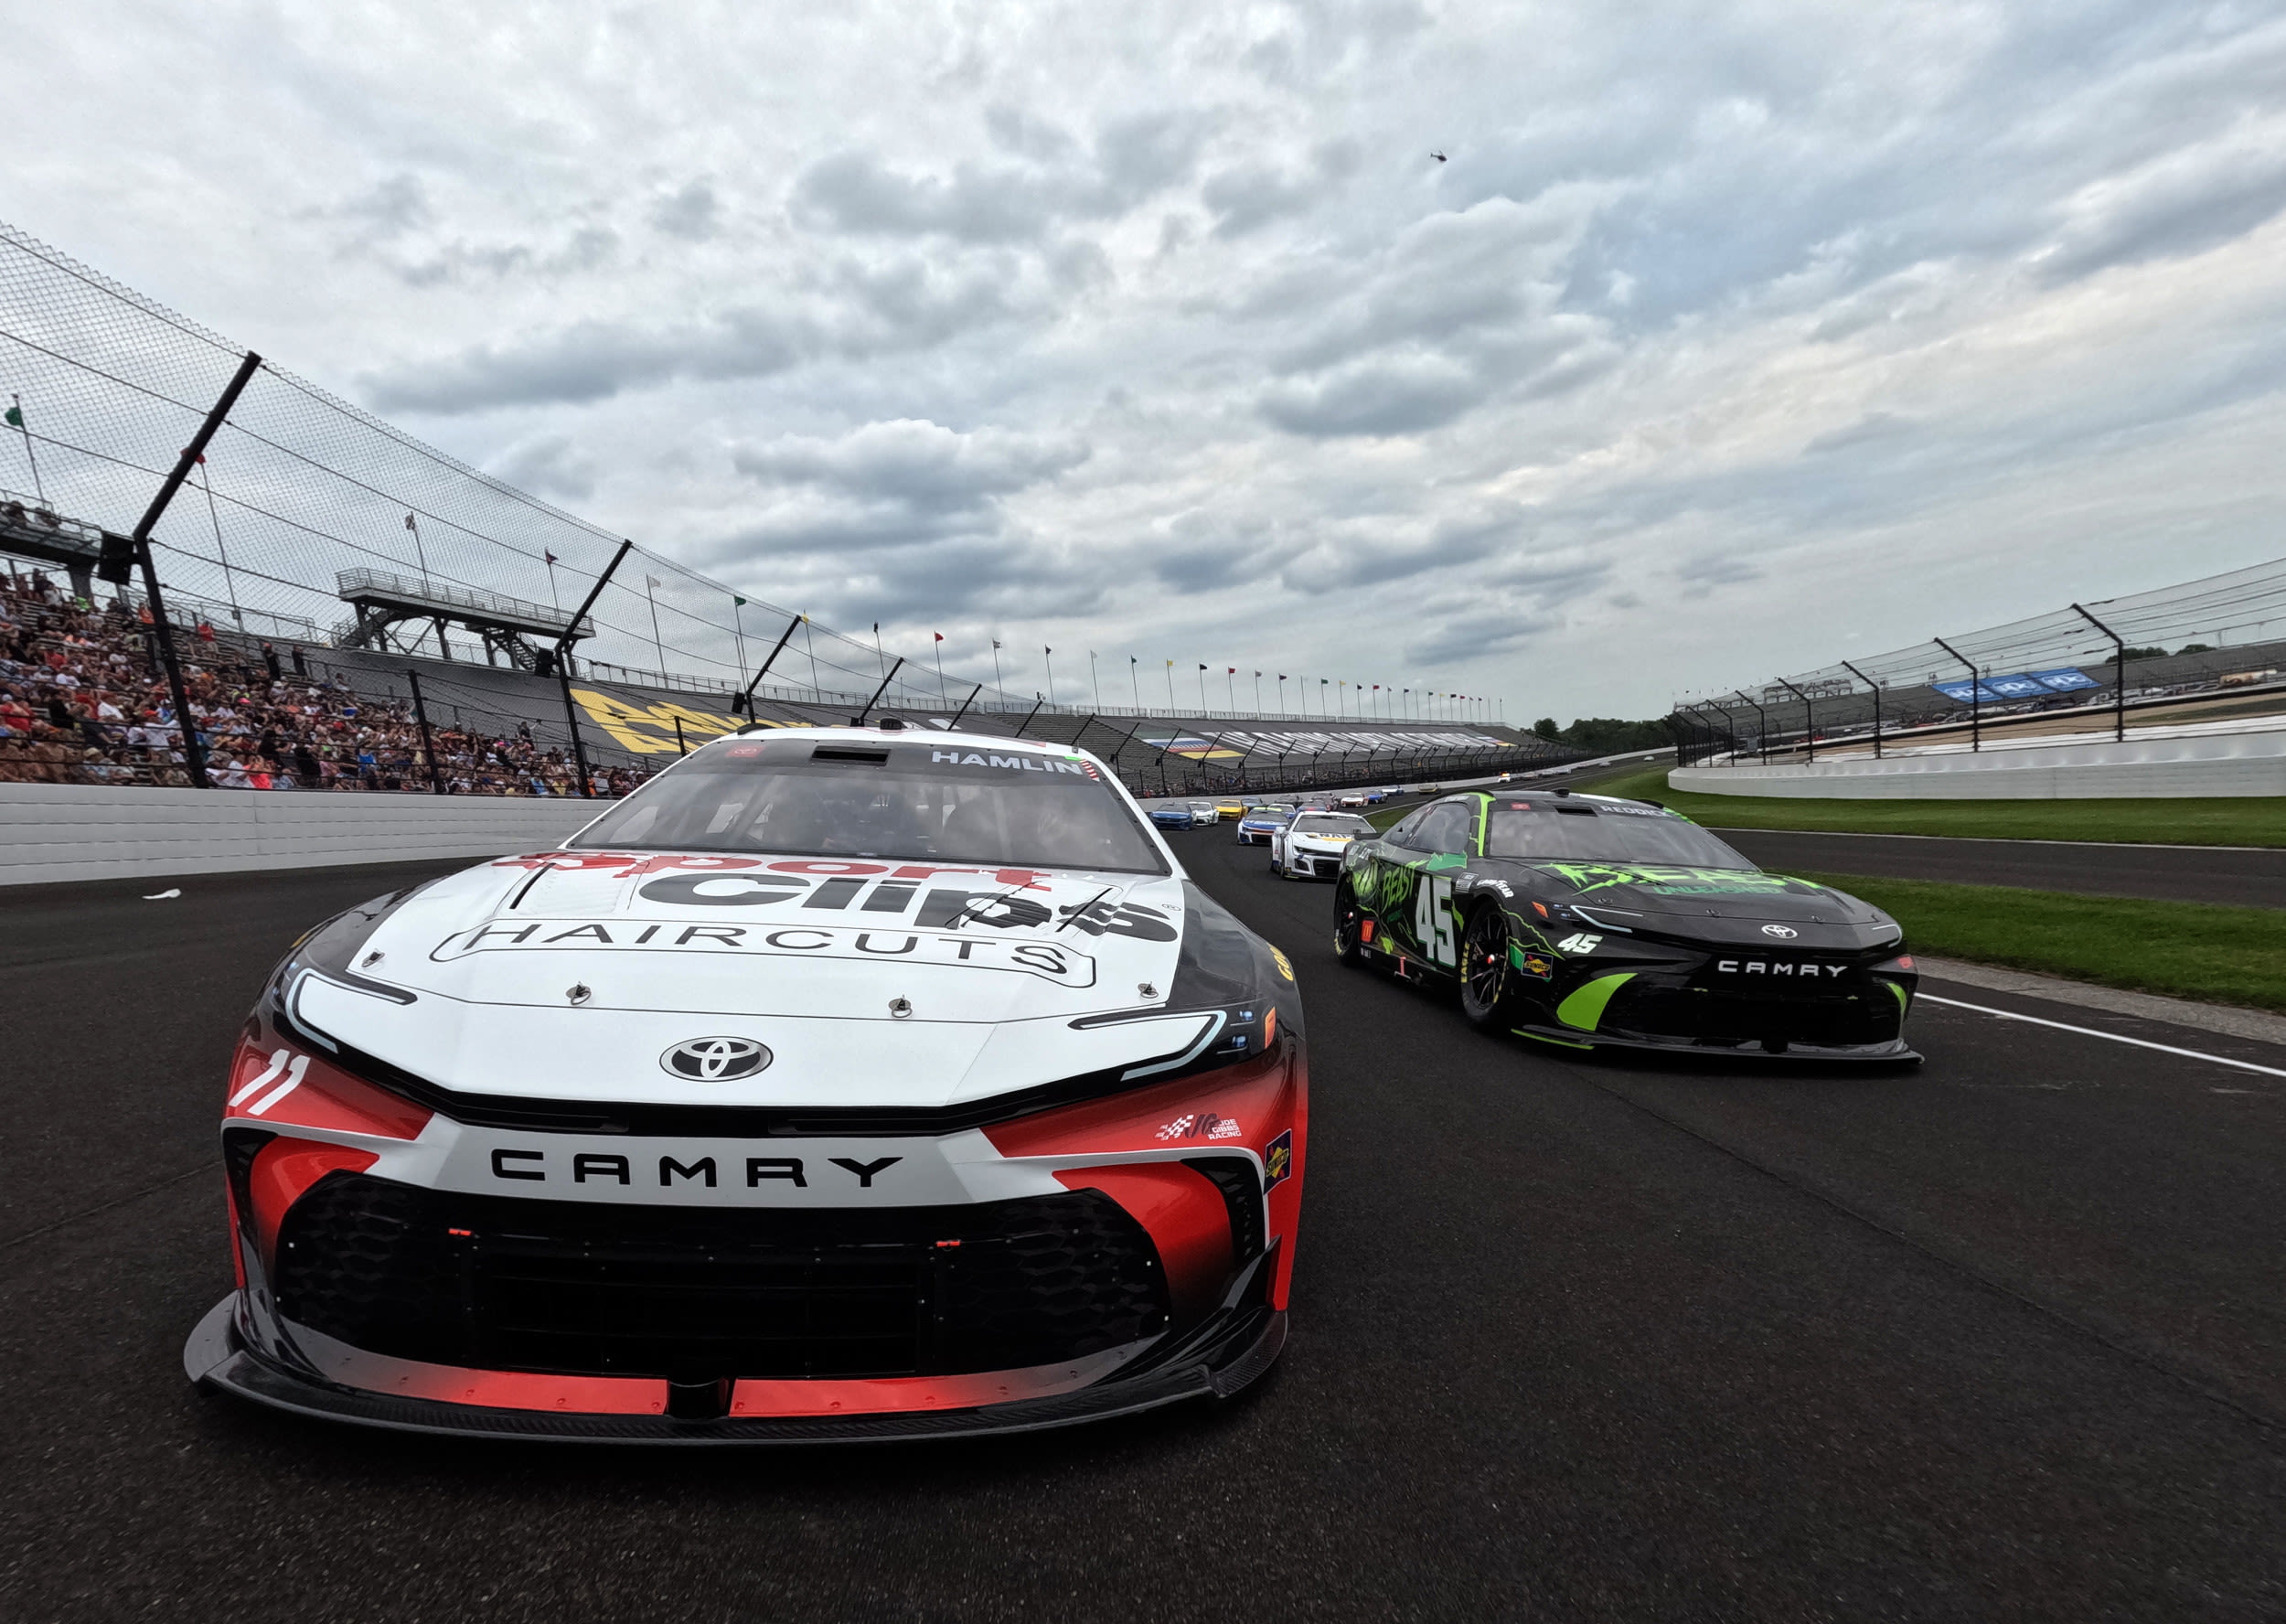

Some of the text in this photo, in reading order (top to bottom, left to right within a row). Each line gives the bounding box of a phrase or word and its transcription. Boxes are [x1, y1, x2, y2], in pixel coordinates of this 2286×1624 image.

[932, 752, 1083, 775] HAMLIN
[1600, 806, 1673, 818] REDDICK
[1416, 874, 1457, 967] 45
[463, 924, 1067, 974] HAIRCUTS
[1557, 933, 1604, 954] 45
[1718, 959, 1848, 978] CAMRY
[229, 1048, 311, 1116] 11
[1212, 1125, 1241, 1133] GIBBS
[1219, 1118, 1237, 1127] JOE
[1208, 1130, 1242, 1139] RACING
[491, 1149, 903, 1188] CAMRY
